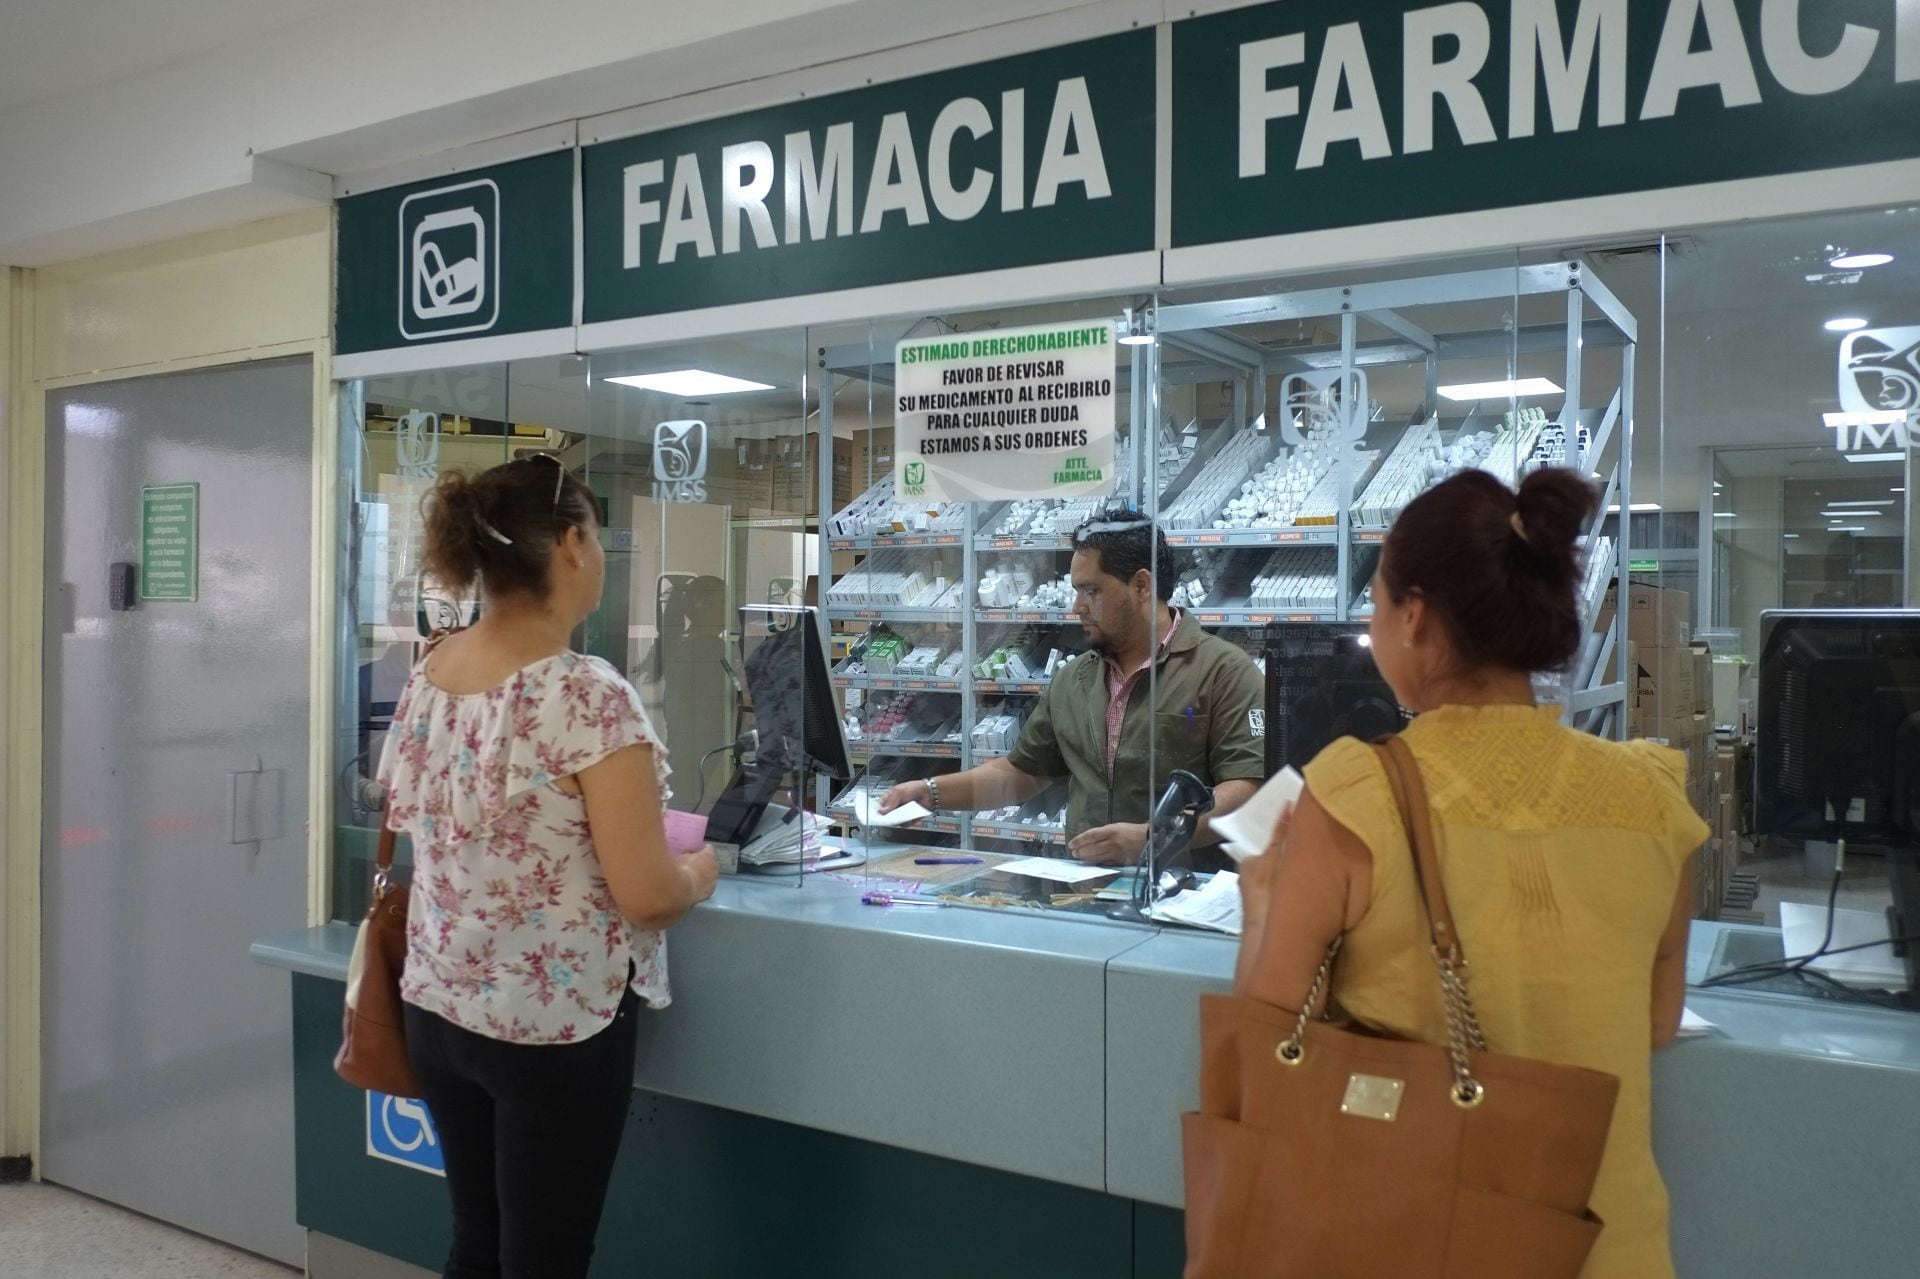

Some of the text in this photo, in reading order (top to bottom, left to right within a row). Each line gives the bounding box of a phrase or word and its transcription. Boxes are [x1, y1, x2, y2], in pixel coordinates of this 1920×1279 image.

[623, 76, 1112, 269] FARMACIA
[901, 326, 1108, 365] ESTIMADO DERECHOHABIENTE
[943, 360, 1065, 386] FAVOR DE REVISAR
[899, 379, 1111, 412] SU MEDICAMENTO AL RECIBIRLO
[927, 405, 1079, 430] PARA CUALQUIER DUDA
[920, 429, 1088, 455] ESTAMOS A SUS ORDENES
[1065, 457, 1089, 470] ATTE.
[1053, 469, 1103, 484] FARMACIA
[652, 479, 708, 504] IMSS
[904, 485, 925, 497] IMSS
